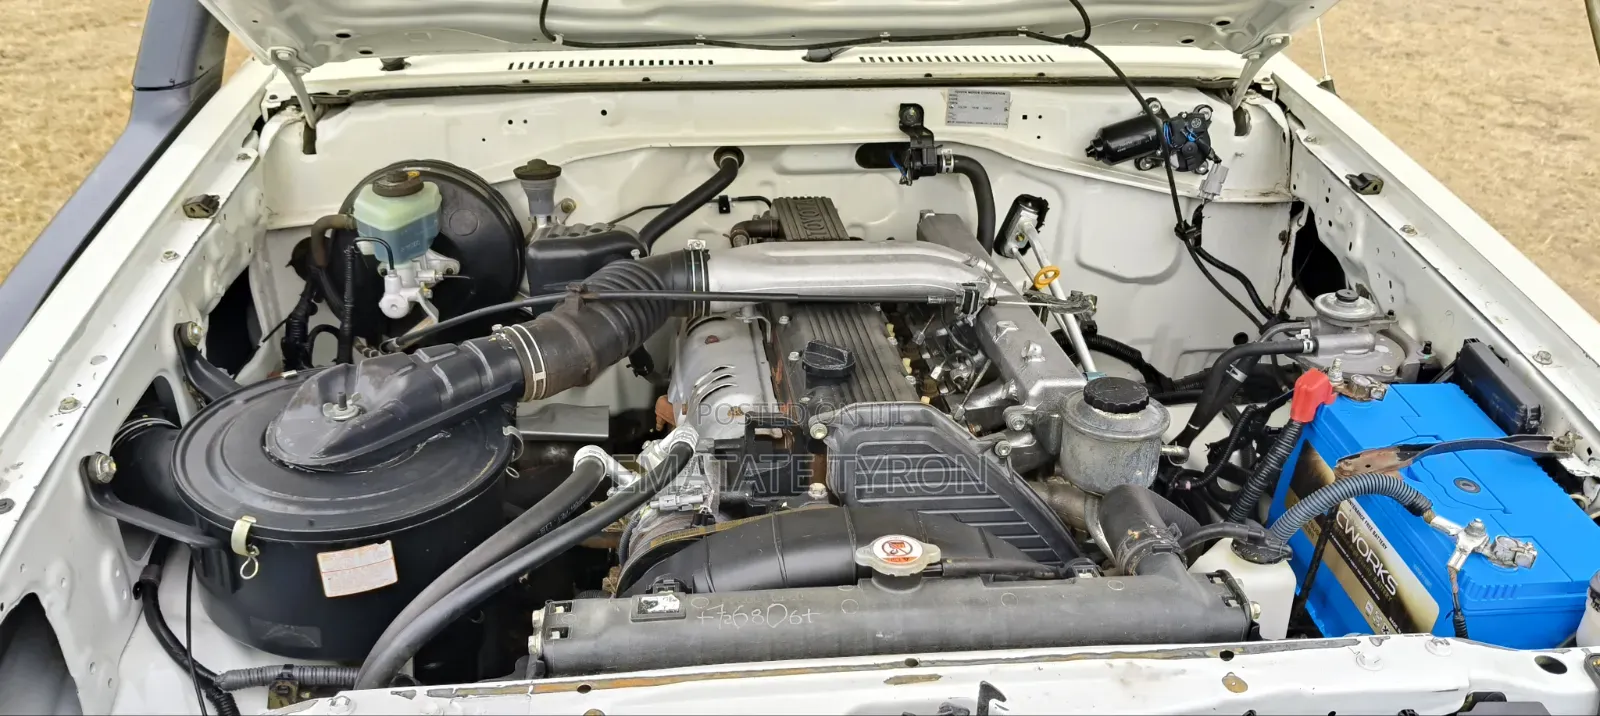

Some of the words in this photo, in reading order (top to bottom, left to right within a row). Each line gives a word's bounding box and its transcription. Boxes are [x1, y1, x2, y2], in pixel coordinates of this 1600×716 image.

[796, 199, 827, 237] TOYOTA
[1336, 510, 1398, 597] CWORKS
[1372, 530, 1388, 550] BATTERY
